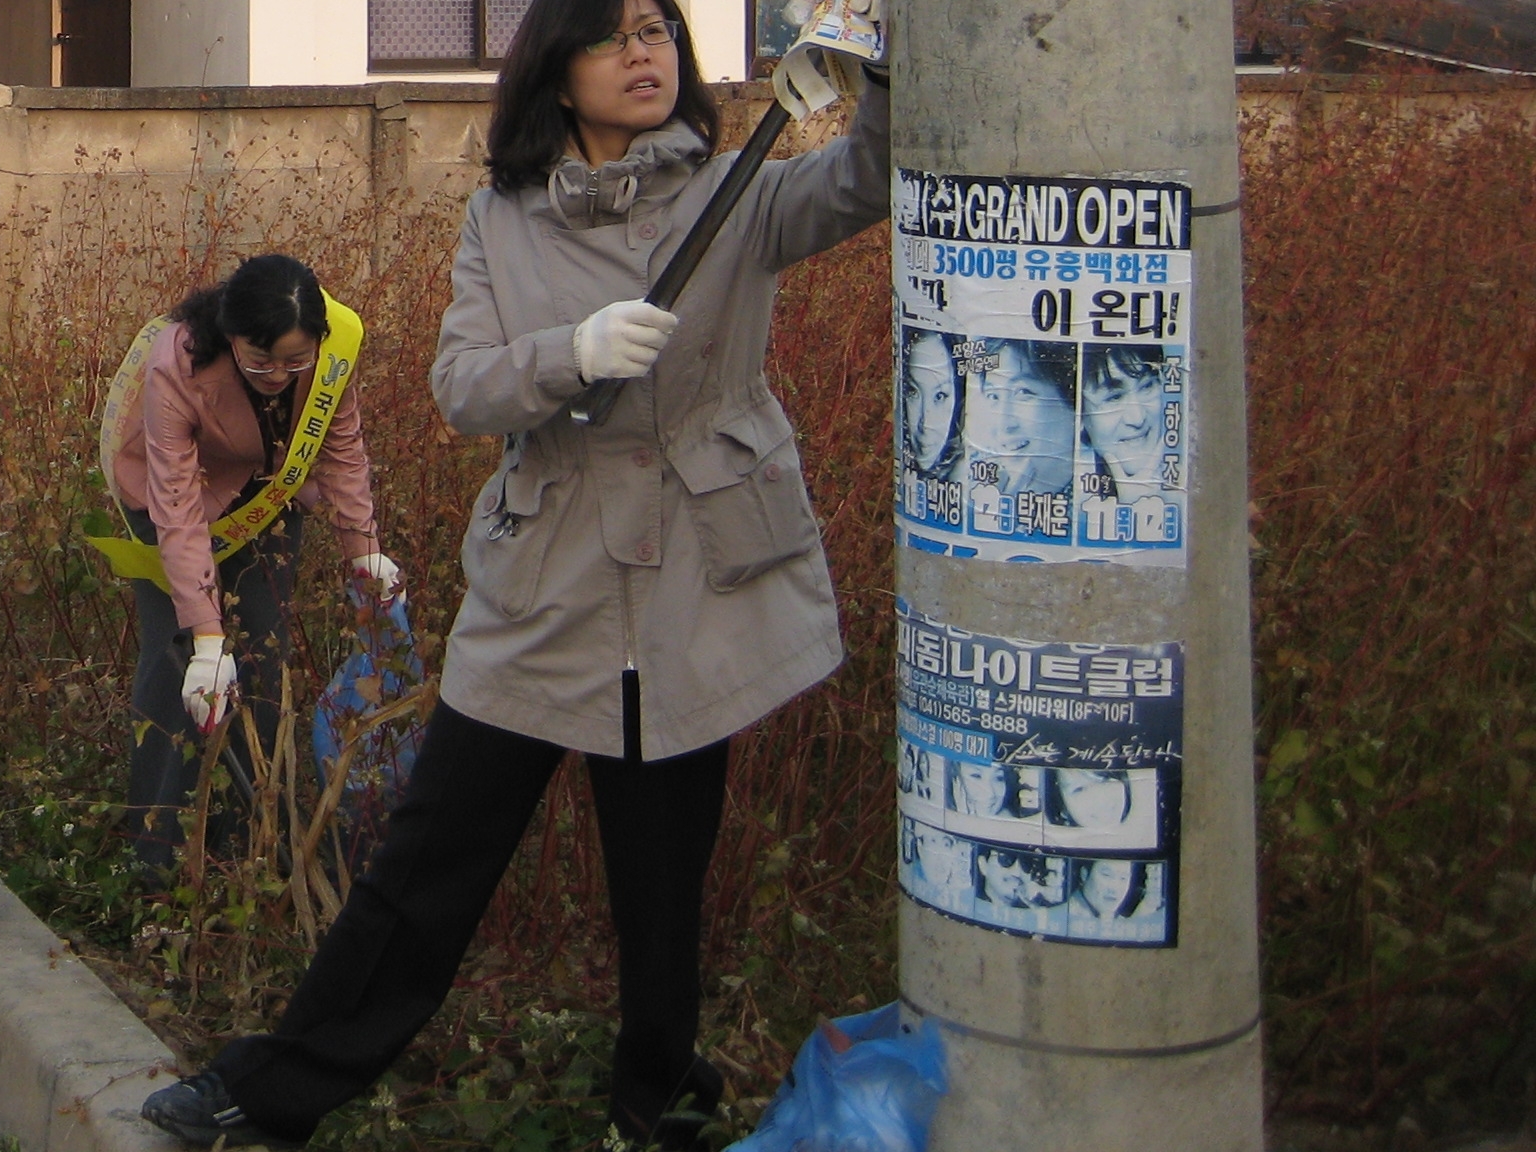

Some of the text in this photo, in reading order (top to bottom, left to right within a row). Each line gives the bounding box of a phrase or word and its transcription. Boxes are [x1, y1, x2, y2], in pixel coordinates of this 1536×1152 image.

[965, 183, 1076, 244] GRAND
[1077, 186, 1182, 247] OPEN
[933, 244, 1017, 280] 3500평
[1024, 249, 1169, 285] 유흥백화점
[1088, 289, 1180, 339] 온다!
[283, 391, 335, 487] 국토사랑
[1017, 489, 1069, 537] 탁재훈
[919, 695, 1028, 735] (041)565-8888
[966, 734, 988, 758] 대기
